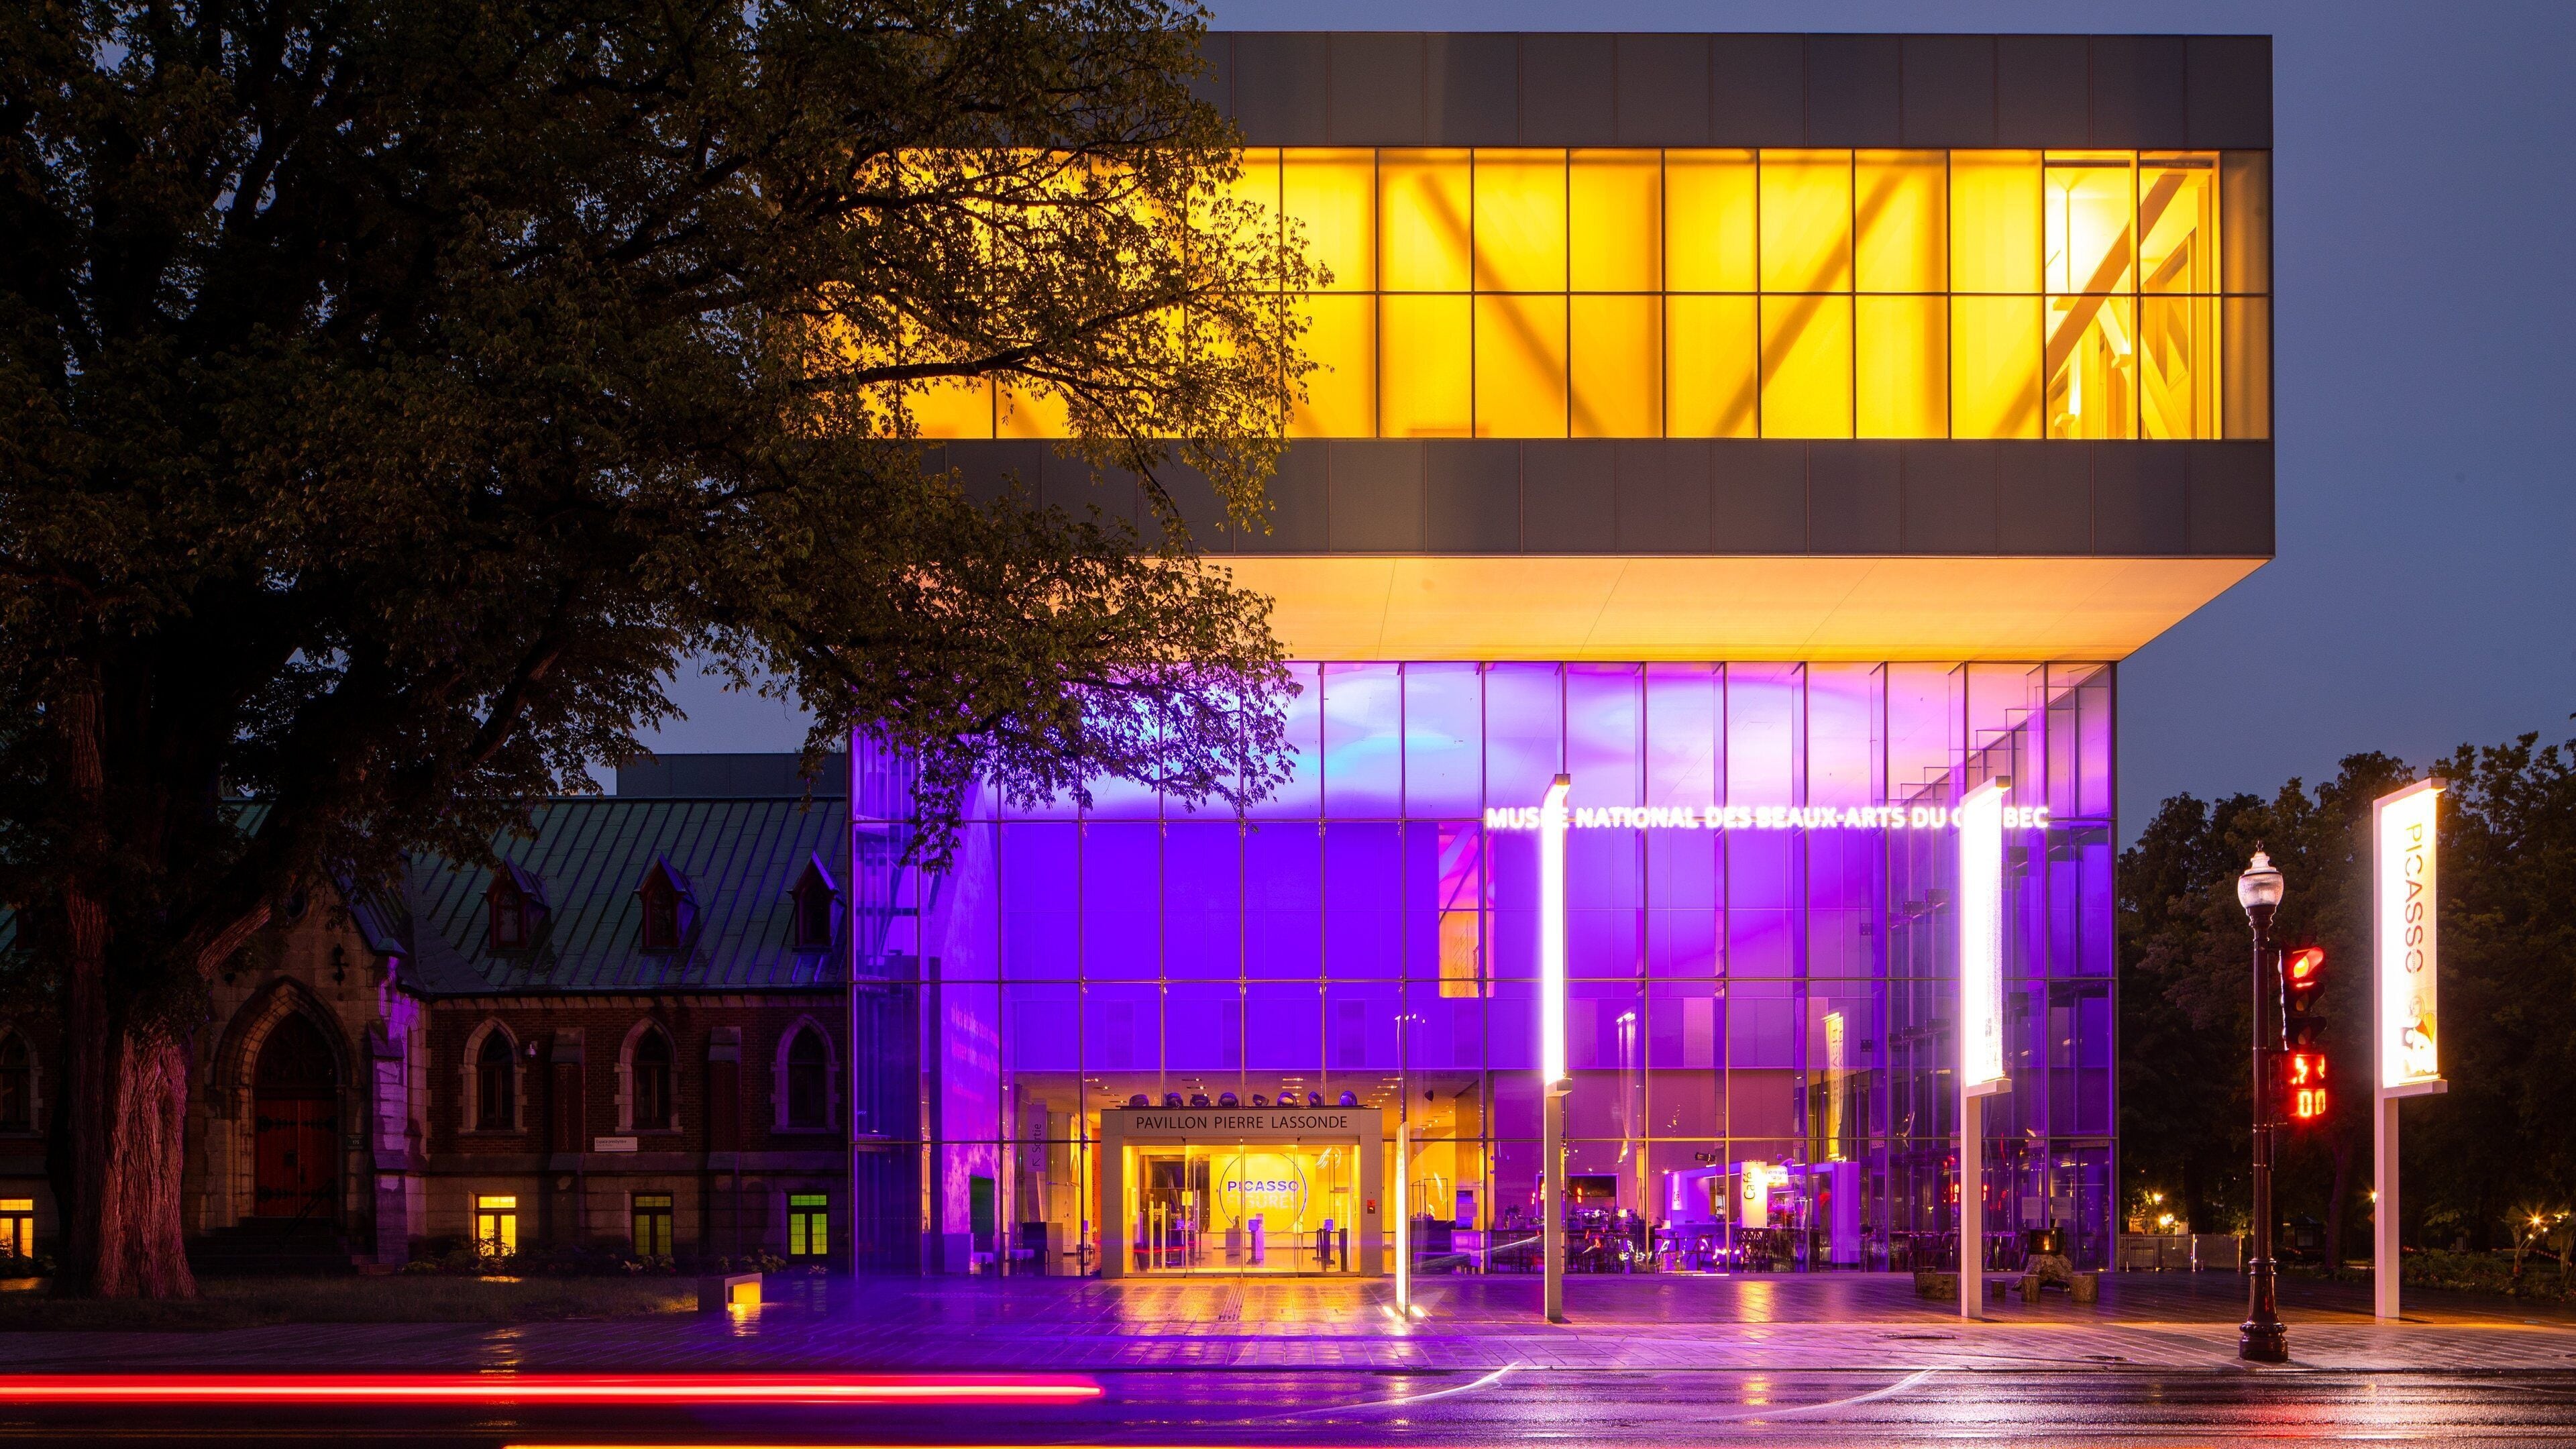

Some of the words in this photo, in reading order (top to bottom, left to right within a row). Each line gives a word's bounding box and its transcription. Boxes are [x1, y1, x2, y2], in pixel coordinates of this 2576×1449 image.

[1575, 806, 1699, 828] NATIONAL
[1705, 806, 1752, 828] DES
[1756, 806, 1907, 828] BEAUX-ARTS
[1912, 806, 1947, 828] DU
[2405, 822, 2424, 974] PICASSO
[1136, 1116, 1208, 1129] PAVILLON
[1214, 1116, 1264, 1129] PIERRE
[1272, 1116, 1348, 1128] LASSONDE
[1032, 1123, 1042, 1153] Sortie
[1227, 1180, 1299, 1192] PICASSO
[1743, 1171, 1756, 1199] Café
